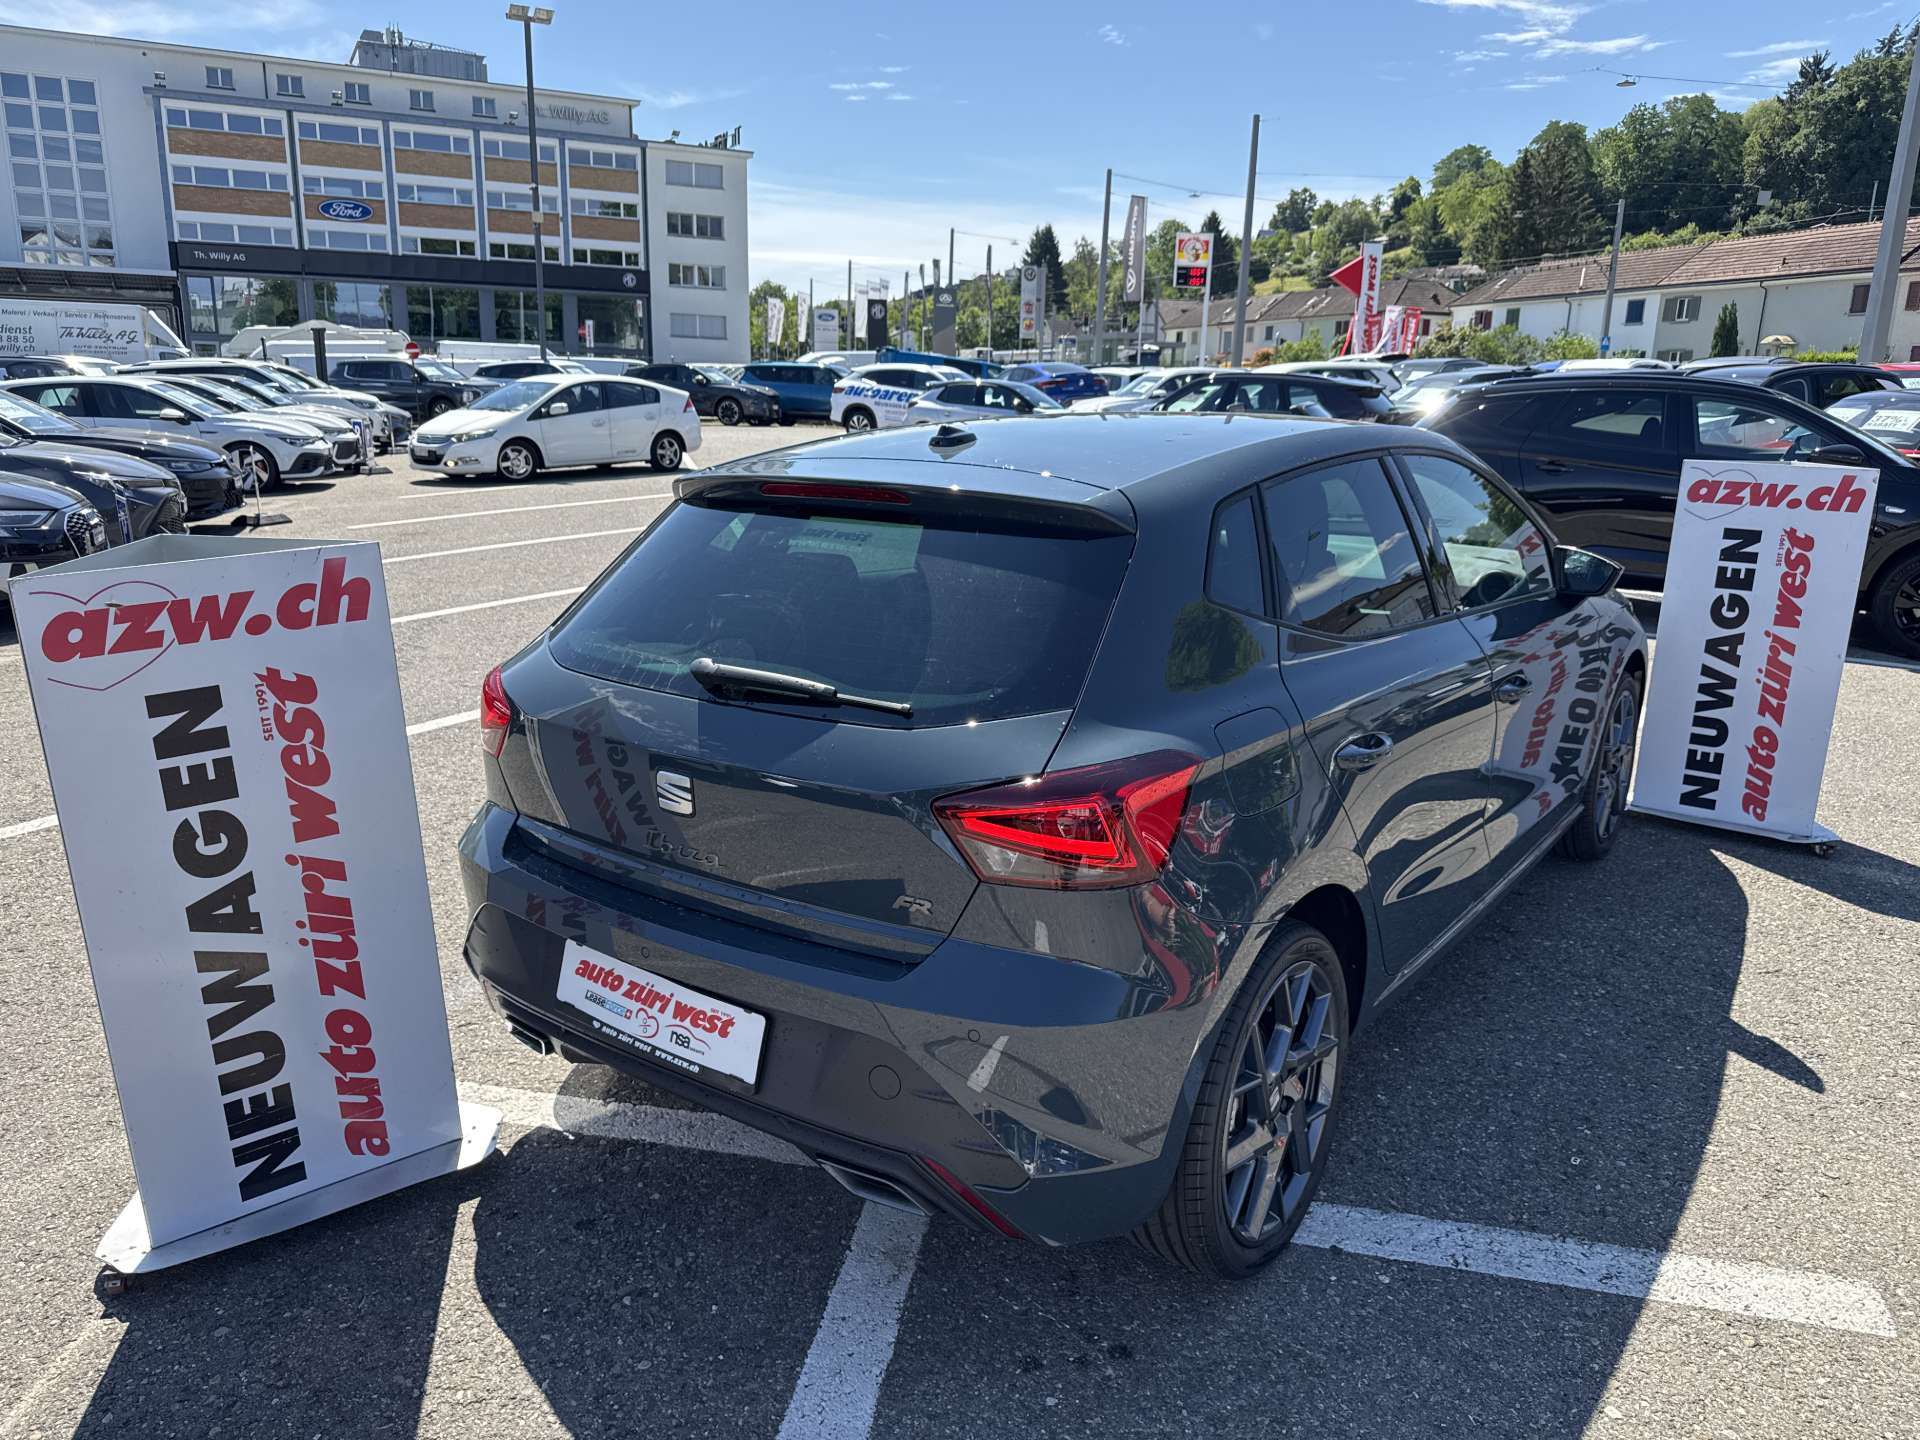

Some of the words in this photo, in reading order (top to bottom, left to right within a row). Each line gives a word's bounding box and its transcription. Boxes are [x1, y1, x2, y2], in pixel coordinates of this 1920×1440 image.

[548, 103, 583, 125] Willy
[585, 109, 610, 124] AG
[329, 202, 363, 218] Ford
[193, 251, 207, 260] Th.
[209, 252, 231, 262] Willy
[233, 253, 247, 262] AG
[22, 336, 35, 344] 50
[1686, 475, 1868, 513] azw.ch
[1773, 526, 1816, 630] west
[41, 557, 373, 663] azw.ch
[255, 683, 269, 712] 1991
[1679, 527, 1763, 811] NEUWAGEN
[1755, 630, 1799, 728] züri
[253, 666, 341, 844] west
[260, 716, 274, 742] SEIT
[1742, 725, 1780, 822] auto
[284, 854, 367, 1000] züri
[892, 895, 933, 915] FR
[144, 684, 308, 1202] NEUWAGEN
[575, 959, 625, 992] auto
[622, 979, 675, 1015] züri
[672, 1000, 736, 1039] west
[601, 1025, 618, 1037] auto
[669, 1030, 691, 1050] nsa
[317, 1008, 390, 1157] auto
